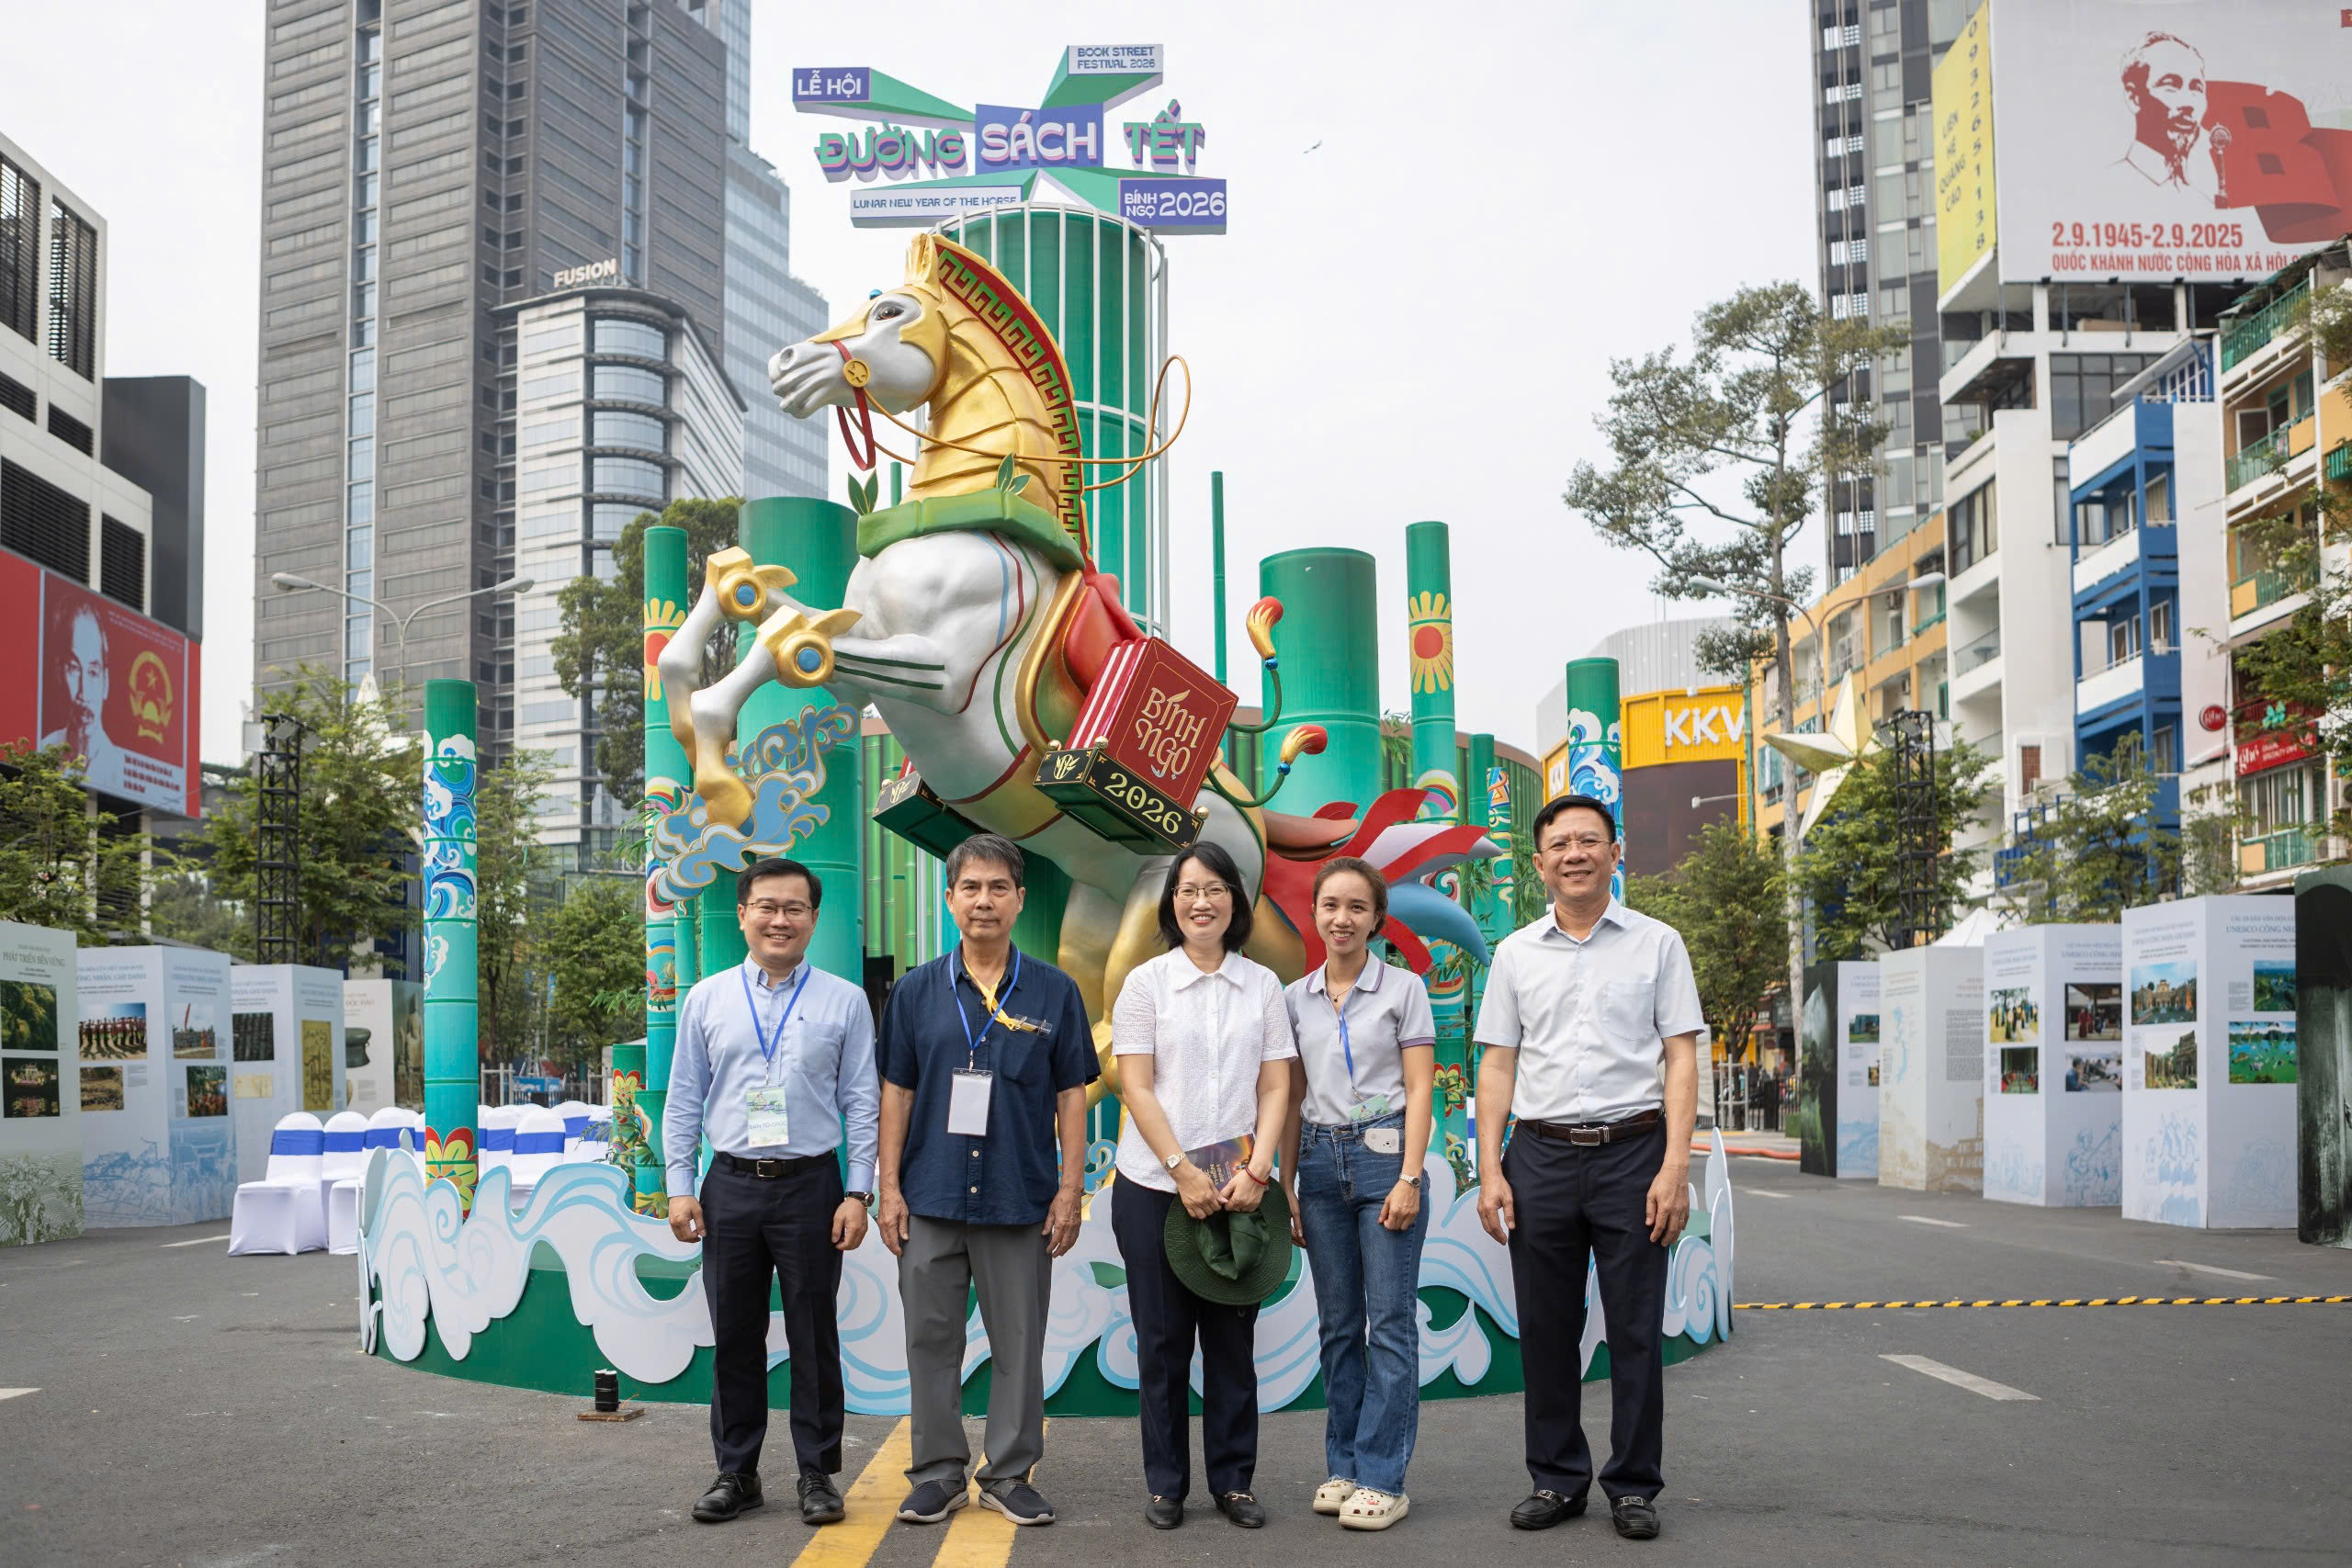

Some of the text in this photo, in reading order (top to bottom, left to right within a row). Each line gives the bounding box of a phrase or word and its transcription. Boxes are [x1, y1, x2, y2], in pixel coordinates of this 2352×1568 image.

[1077, 46, 1155, 57] BOOK STREET
[1077, 58, 1156, 69] FESTIVAL 2026
[797, 70, 861, 98] LỄ HỘI
[814, 118, 967, 171] ĐƯỜNG
[980, 110, 1097, 163] SÁCH
[1123, 98, 1205, 164] TẾT
[854, 199, 888, 209] LUNAR
[889, 198, 913, 208] NEW
[916, 197, 941, 208] YEAR
[943, 197, 957, 207] OF
[959, 197, 979, 207] THE
[1125, 189, 1157, 205] BÍNH
[1159, 191, 1226, 217] 2026
[1125, 205, 1157, 219] NGỌ
[2052, 221, 2243, 248] 2.9.1945-2.9.2025
[553, 257, 617, 288] FUSION
[2052, 248, 2086, 271] QUỐC
[2090, 250, 2133, 272] KHÁNH
[2138, 249, 2174, 272] NƯỚC
[2177, 251, 2211, 275] CỘNG
[2245, 251, 2263, 272] XÃ
[1665, 705, 1745, 747] KKV
[1104, 772, 1183, 834] 2026
